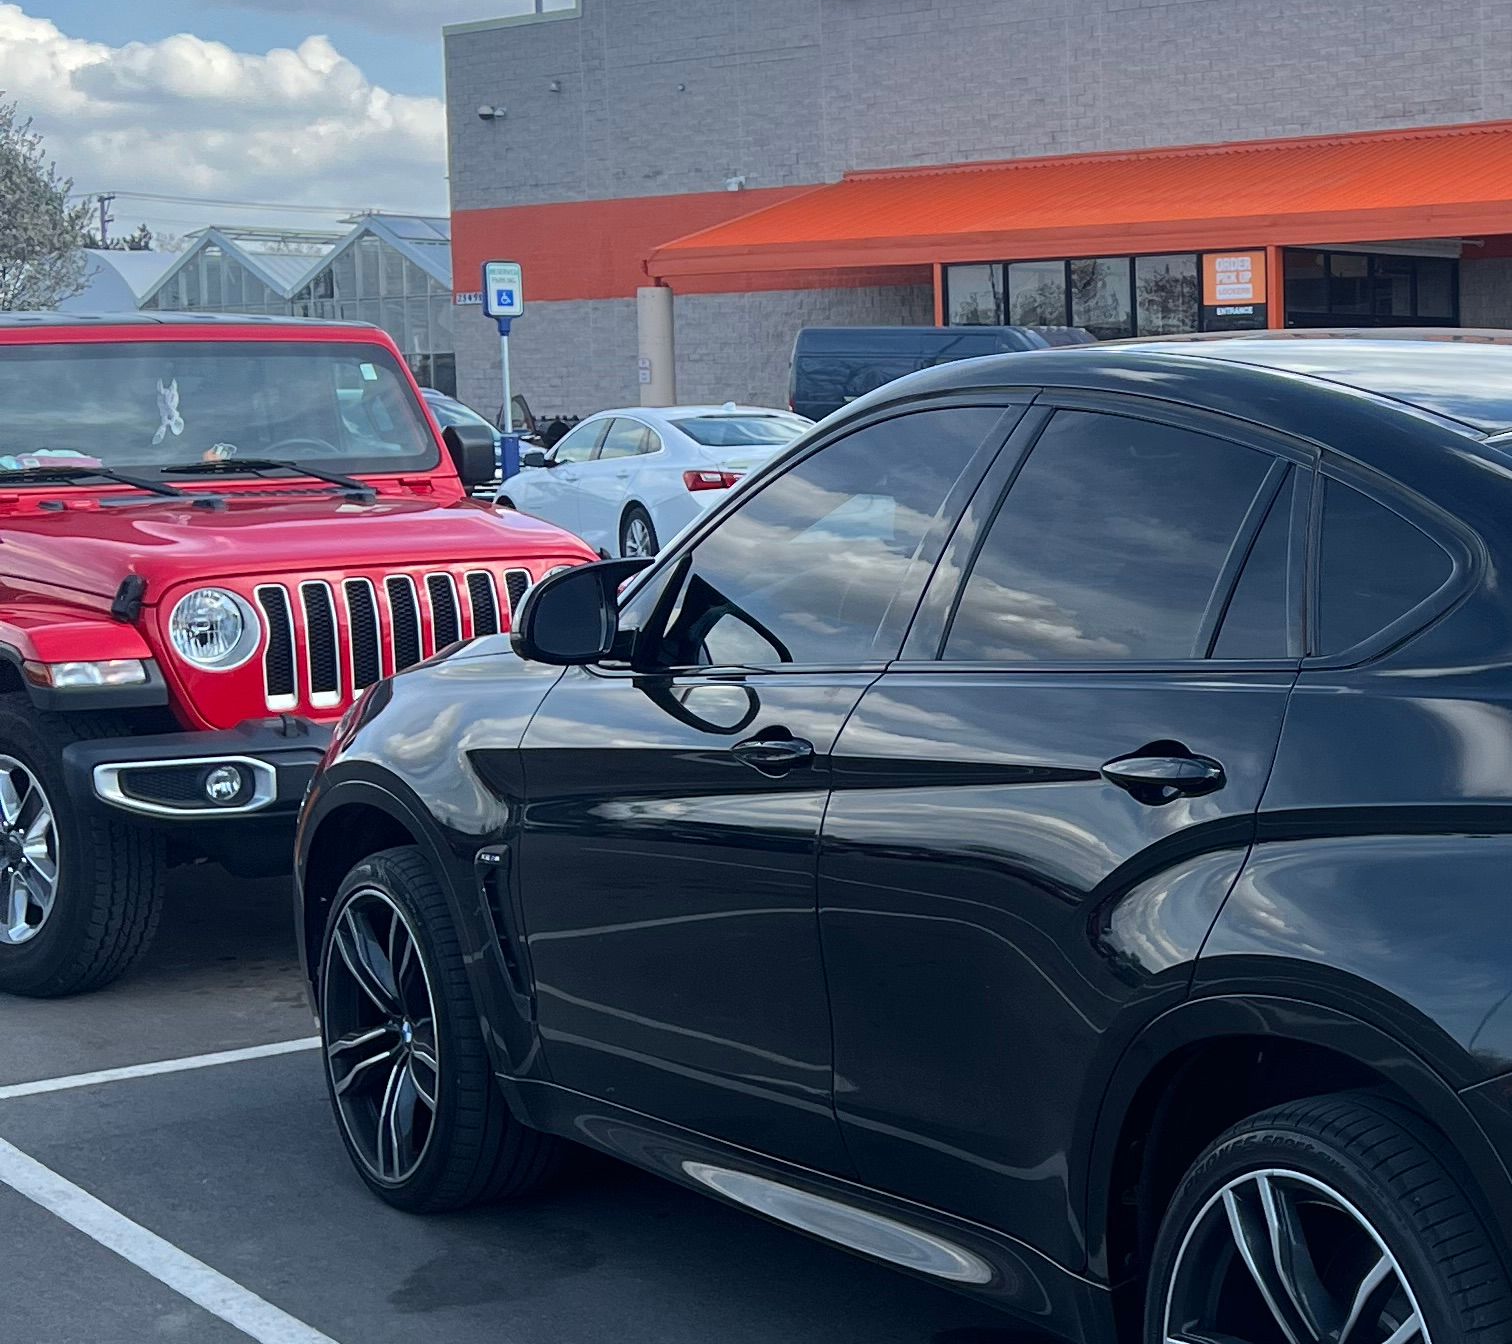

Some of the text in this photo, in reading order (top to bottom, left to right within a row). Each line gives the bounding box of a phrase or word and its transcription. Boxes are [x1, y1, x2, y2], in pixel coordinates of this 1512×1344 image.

[1216, 257, 1251, 272] ORDER
[1216, 272, 1237, 284] PICK
[1216, 306, 1253, 316] ENTRANCE
